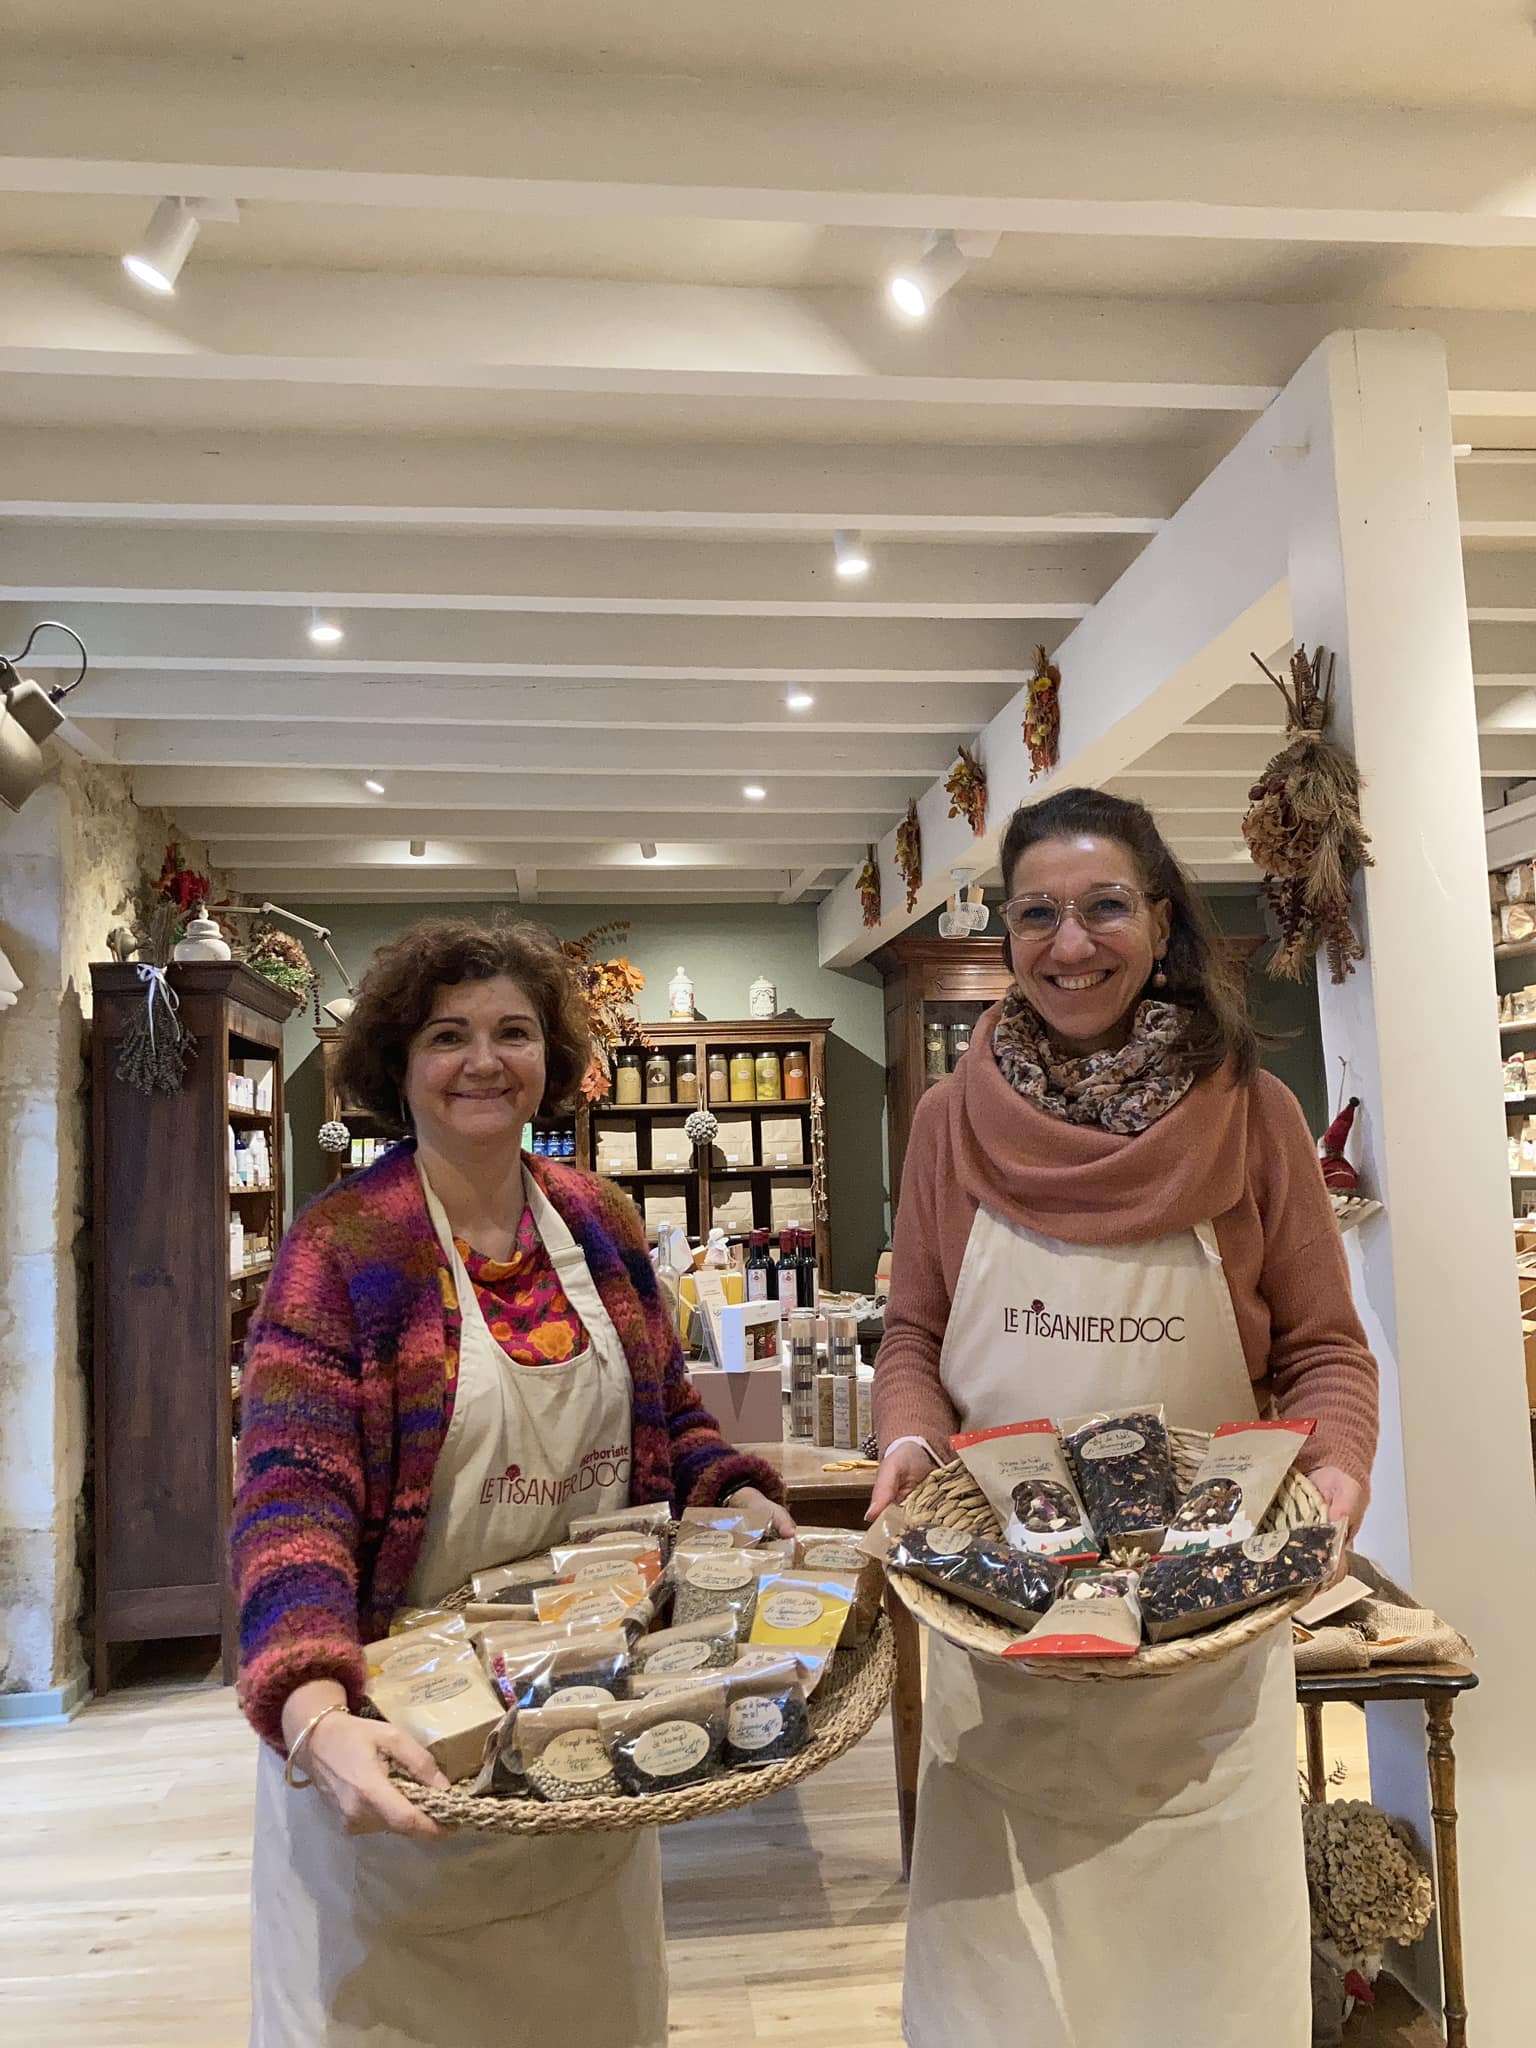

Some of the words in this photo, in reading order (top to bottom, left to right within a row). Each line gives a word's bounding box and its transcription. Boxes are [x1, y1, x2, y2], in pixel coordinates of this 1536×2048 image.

[1004, 1307, 1020, 1333] LE
[1119, 1316, 1186, 1343] D'OC
[580, 1445, 629, 1468] erboriste
[479, 1478, 494, 1504] LE
[579, 1458, 630, 1492] D'OC
